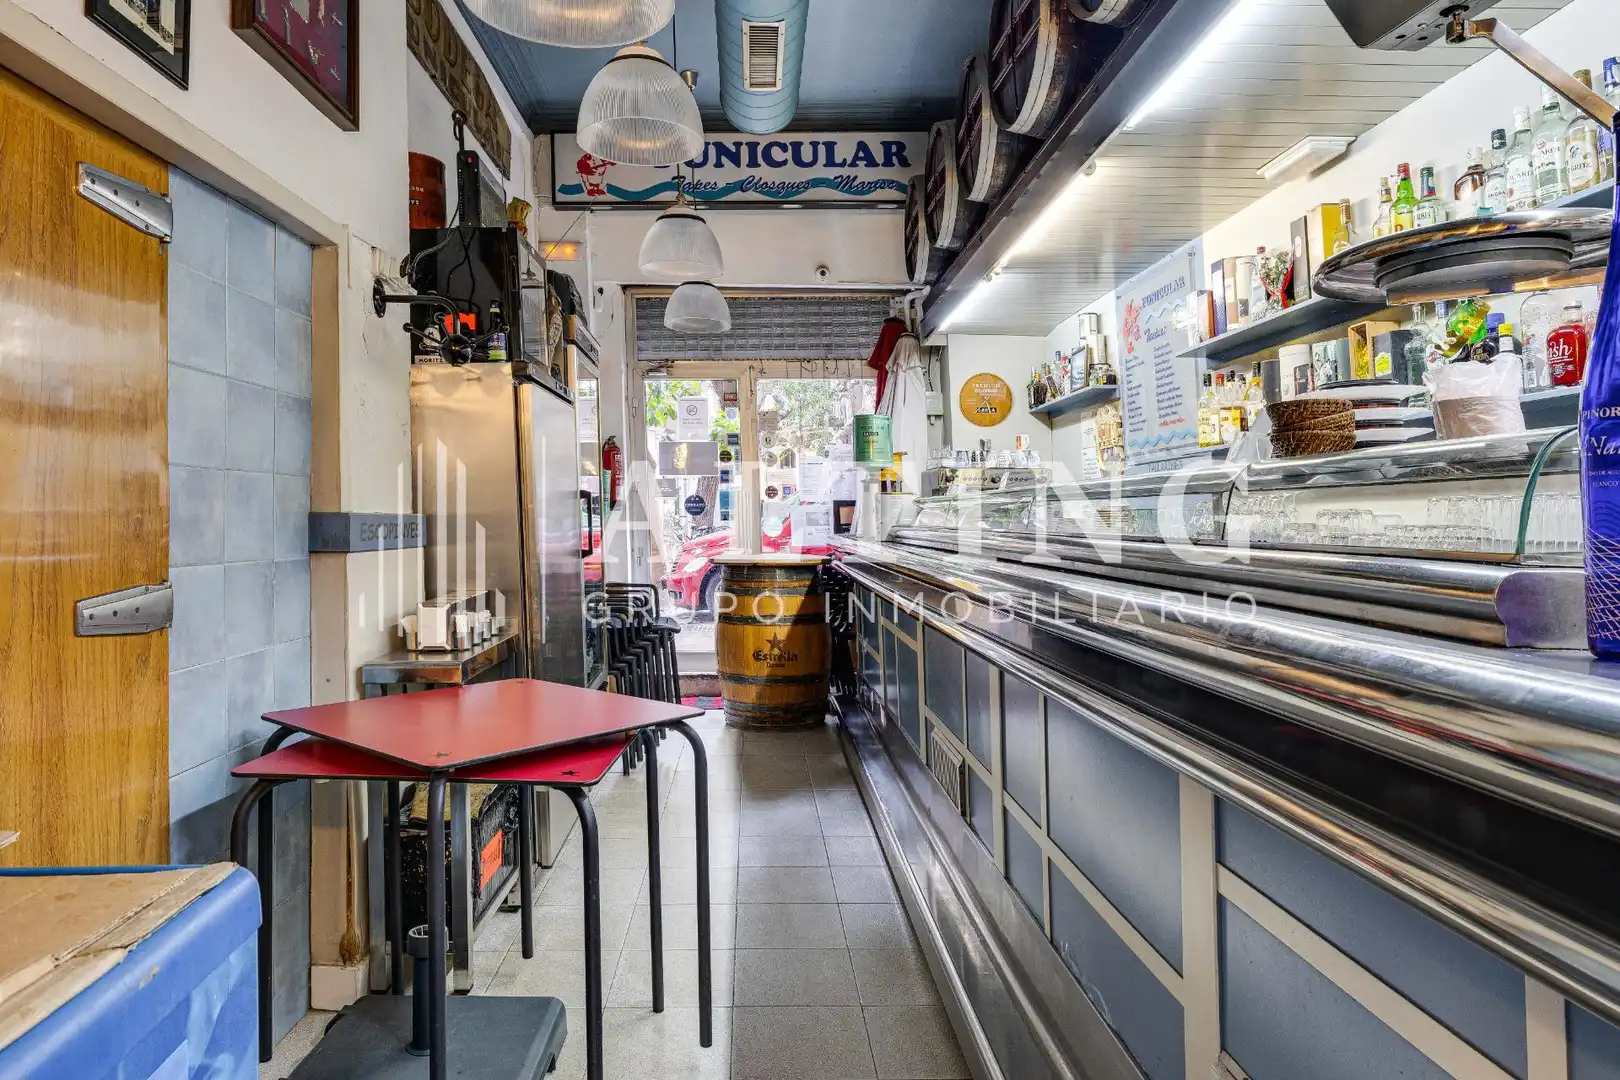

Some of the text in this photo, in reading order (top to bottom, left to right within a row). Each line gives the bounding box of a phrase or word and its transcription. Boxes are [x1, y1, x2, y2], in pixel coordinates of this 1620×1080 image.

[653, 140, 912, 168] UNICULAR
[740, 174, 812, 195] Closques
[360, 521, 421, 542] ESCOPINYES
